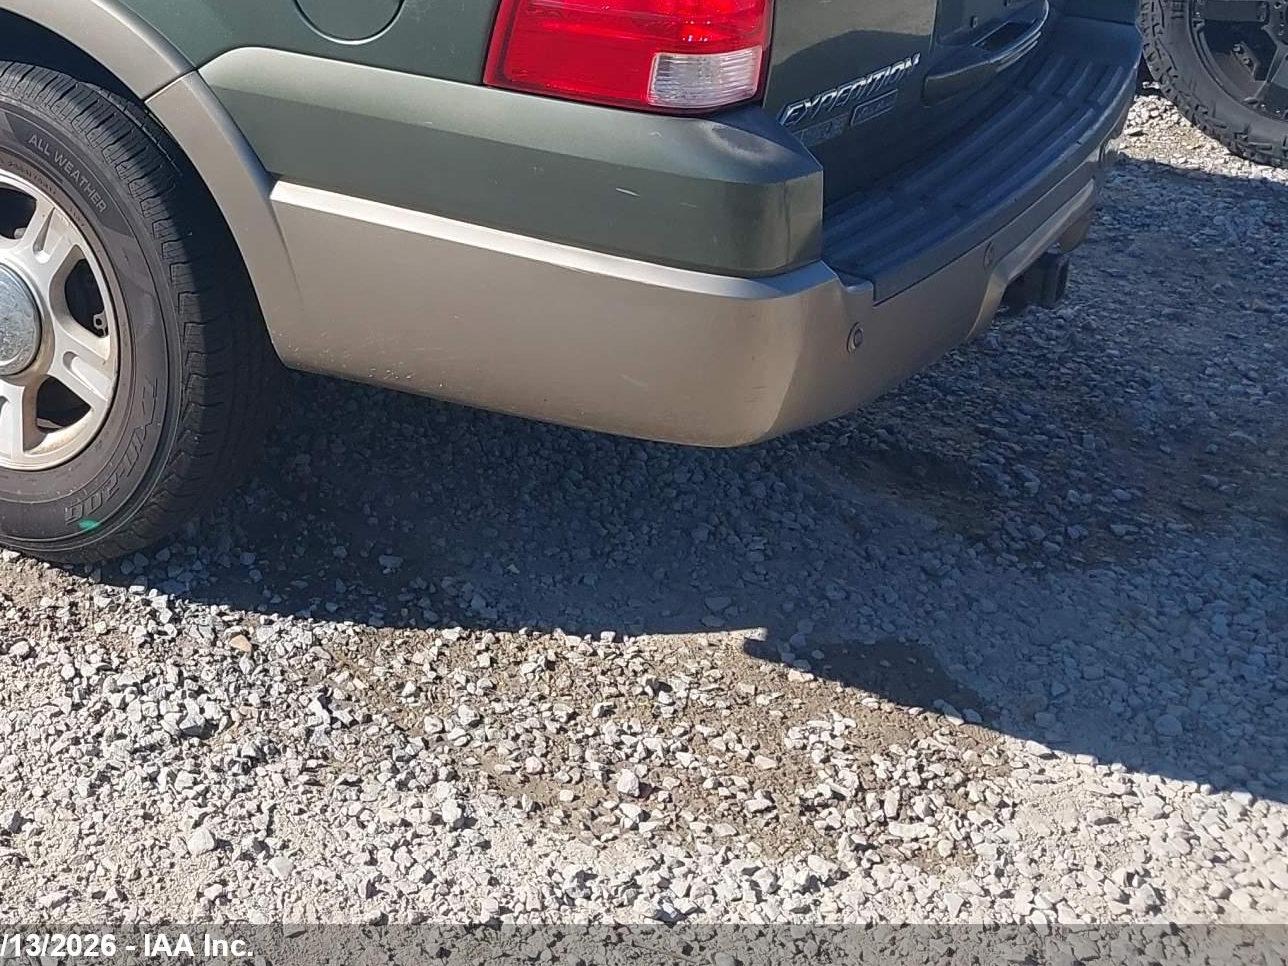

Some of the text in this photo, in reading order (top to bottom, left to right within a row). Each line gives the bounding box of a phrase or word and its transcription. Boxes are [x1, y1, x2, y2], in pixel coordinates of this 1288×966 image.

[777, 51, 921, 126] EXPEDITION
[28, 134, 51, 156] ALL
[53, 151, 108, 213] WEATHER
